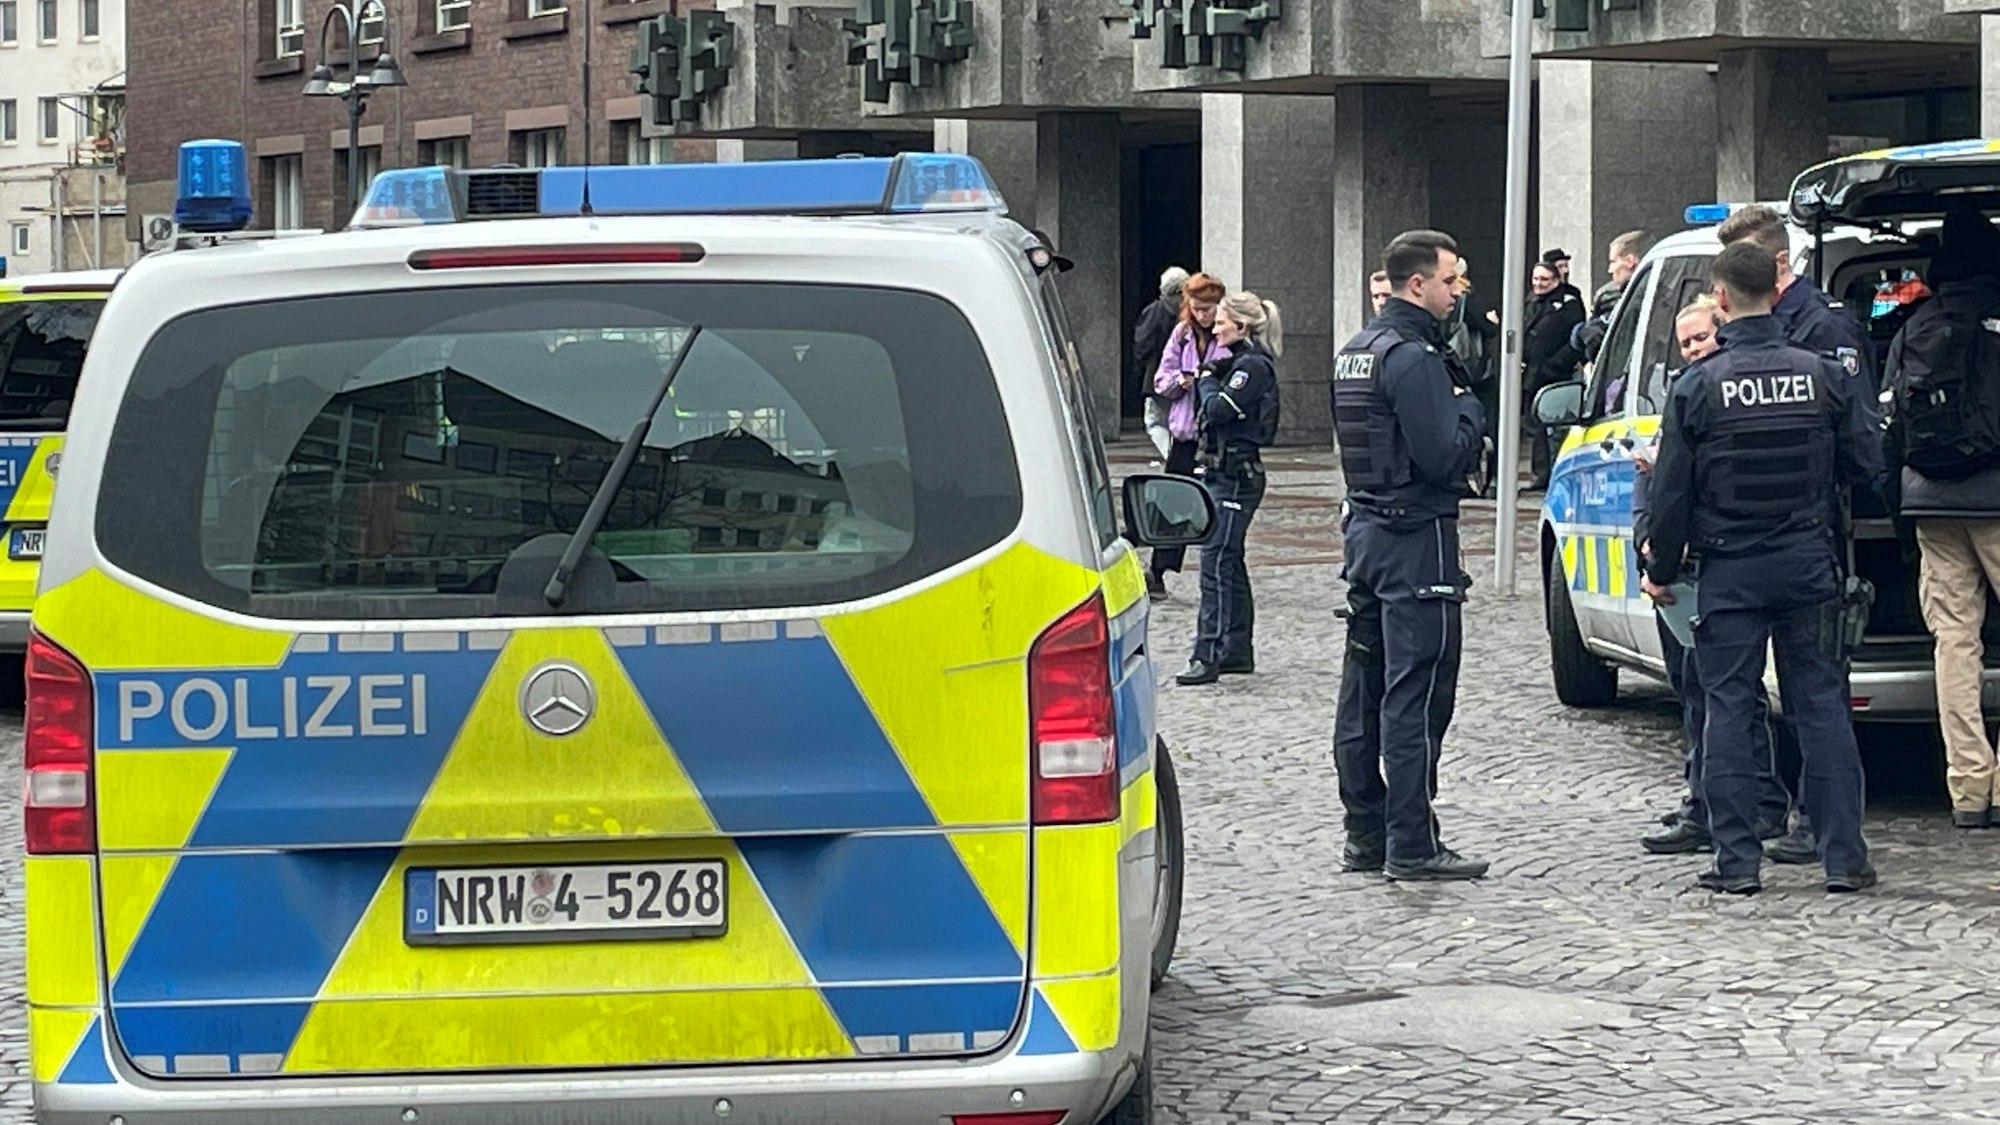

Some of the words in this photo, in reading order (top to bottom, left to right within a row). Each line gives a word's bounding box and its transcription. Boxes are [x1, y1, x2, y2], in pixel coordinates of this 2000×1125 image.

[1721, 374, 1815, 408] POLIZEI
[21, 533, 46, 552] NR
[119, 673, 427, 741] POLIZEI
[438, 875, 525, 926] NRW
[554, 868, 720, 921] 4-5268
[416, 908, 428, 923] D
